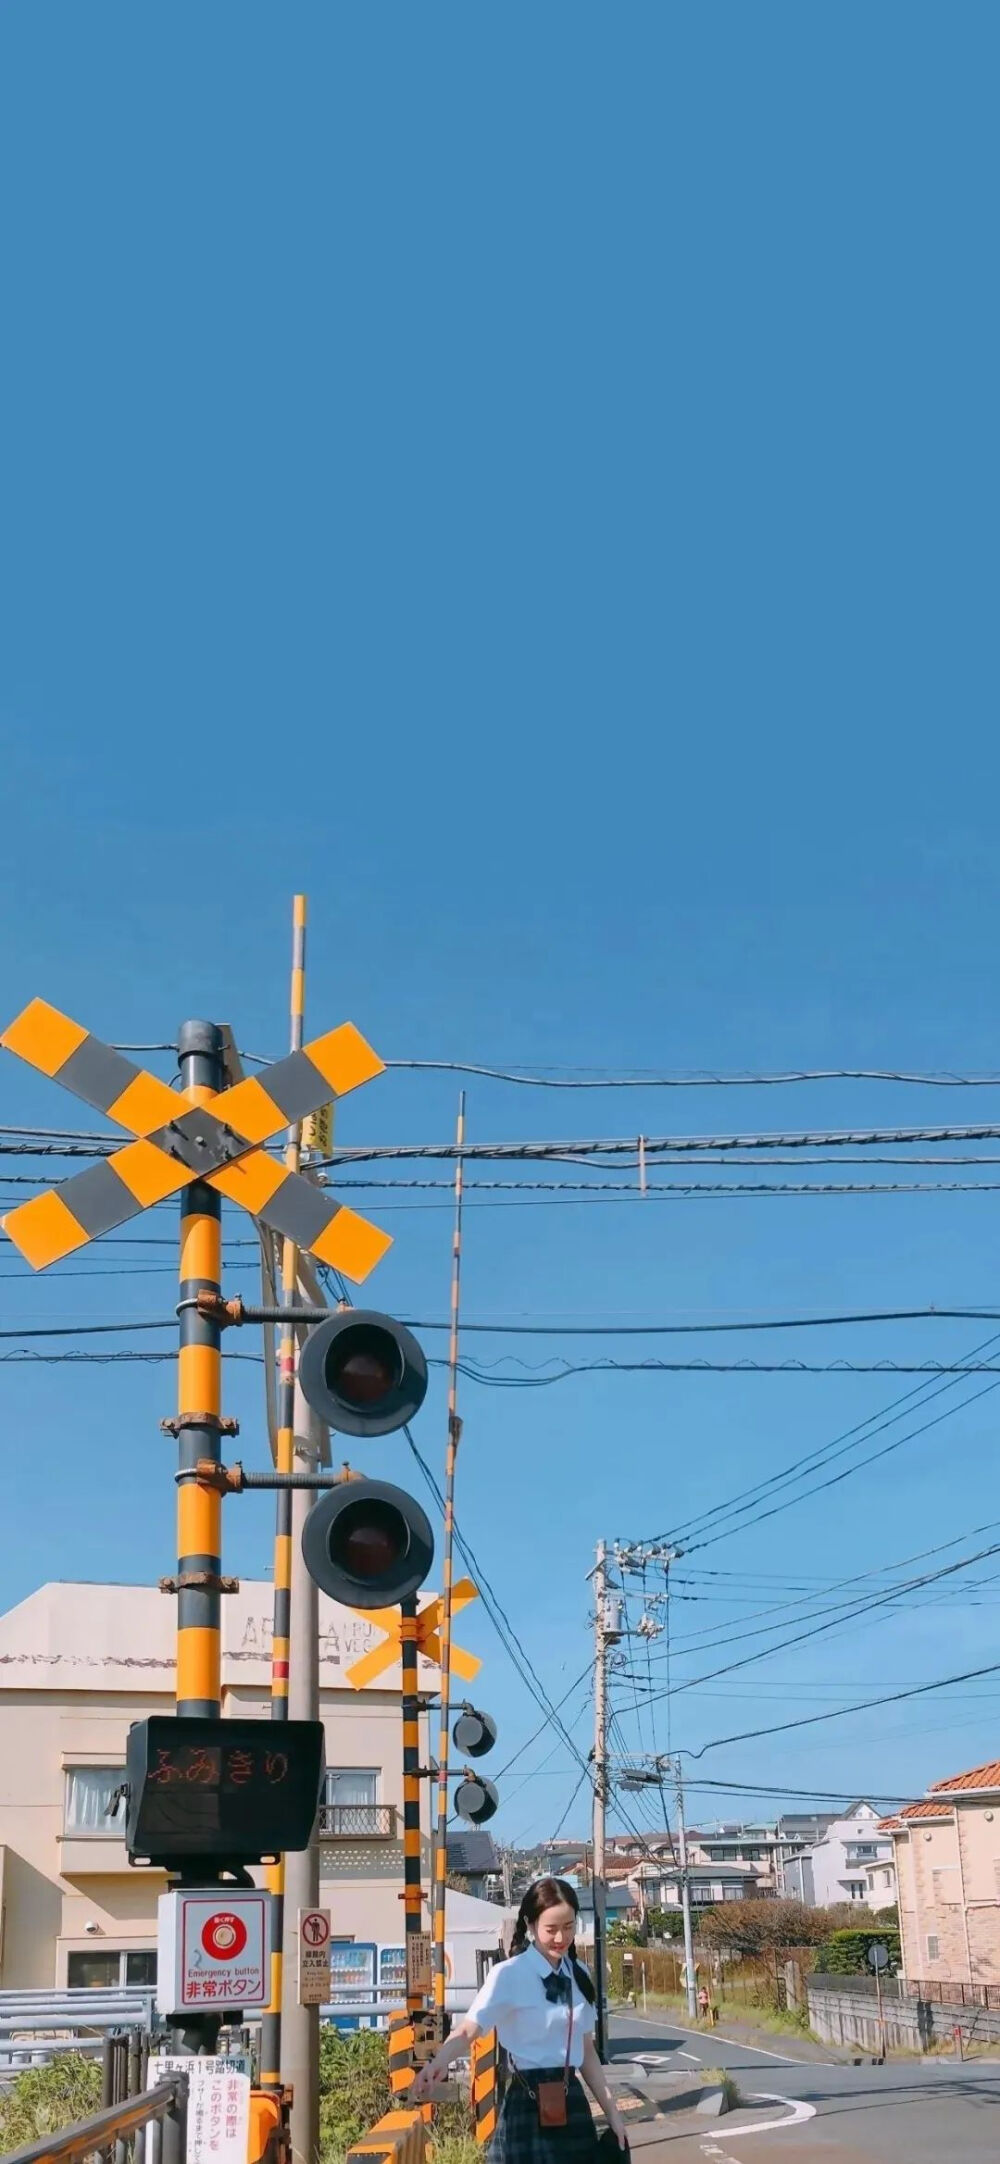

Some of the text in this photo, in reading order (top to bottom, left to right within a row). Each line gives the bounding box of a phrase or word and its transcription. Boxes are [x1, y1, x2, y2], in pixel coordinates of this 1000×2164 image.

[148, 1749, 288, 1783] ふみきり
[186, 1979, 261, 1998] 非常ボタン
[188, 1967, 259, 1978] Emergency button
[194, 2080, 204, 2164] ブザーが鳴るまで押して
[209, 2080, 222, 2151] このボタンを
[226, 2079, 238, 2139] 非常の際は
